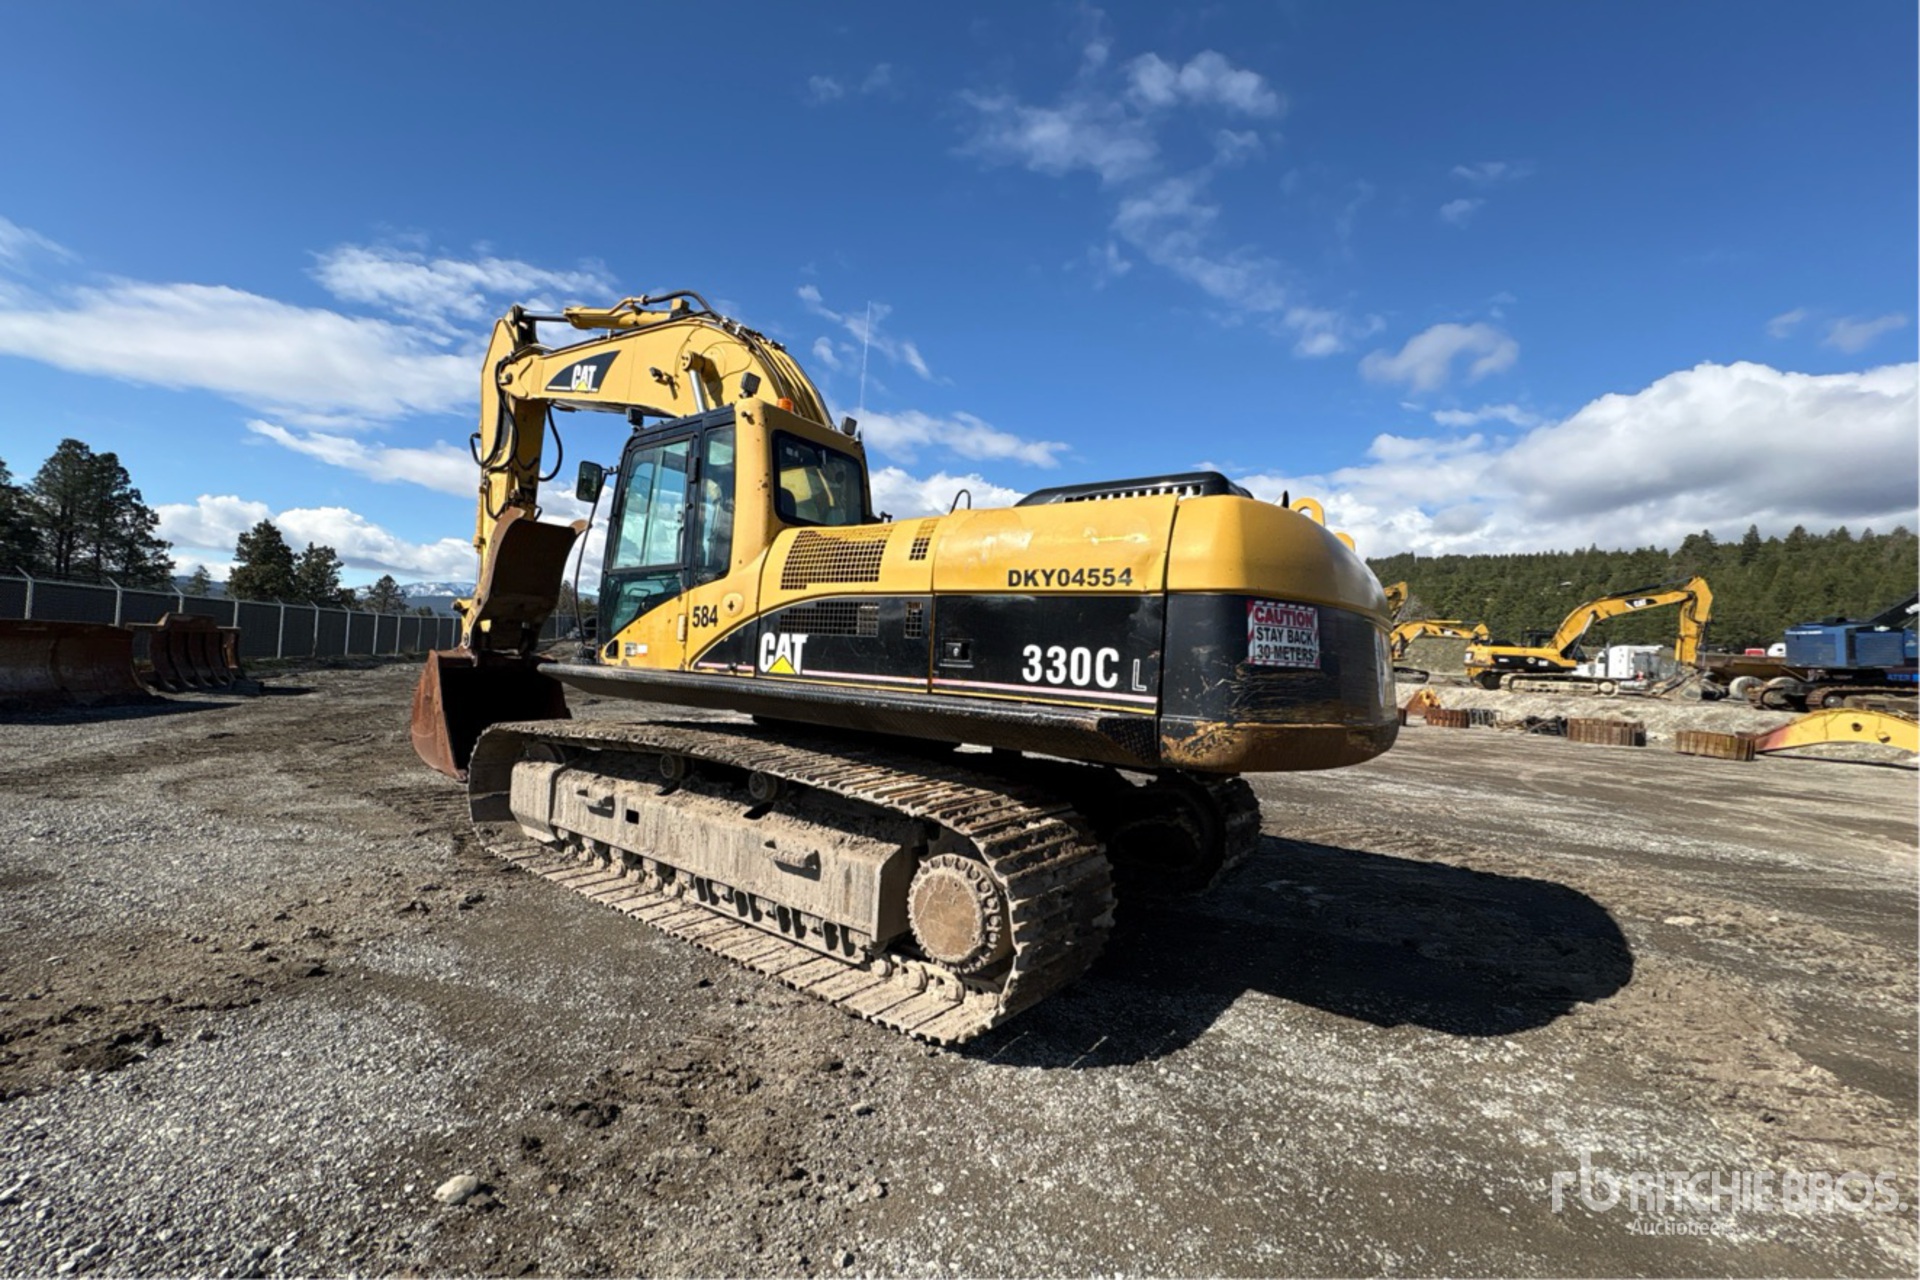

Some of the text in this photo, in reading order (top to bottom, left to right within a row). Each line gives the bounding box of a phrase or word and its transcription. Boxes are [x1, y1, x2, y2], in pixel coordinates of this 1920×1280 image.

[572, 364, 597, 391] CAT
[1008, 567, 1133, 587] DKY04554
[692, 605, 718, 628] 584
[1254, 607, 1313, 627] CAUTION
[1256, 627, 1314, 646] STAY BACK
[759, 632, 809, 675] CAT
[1257, 644, 1314, 663] 30 METERS
[1021, 644, 1148, 692] 330C L
